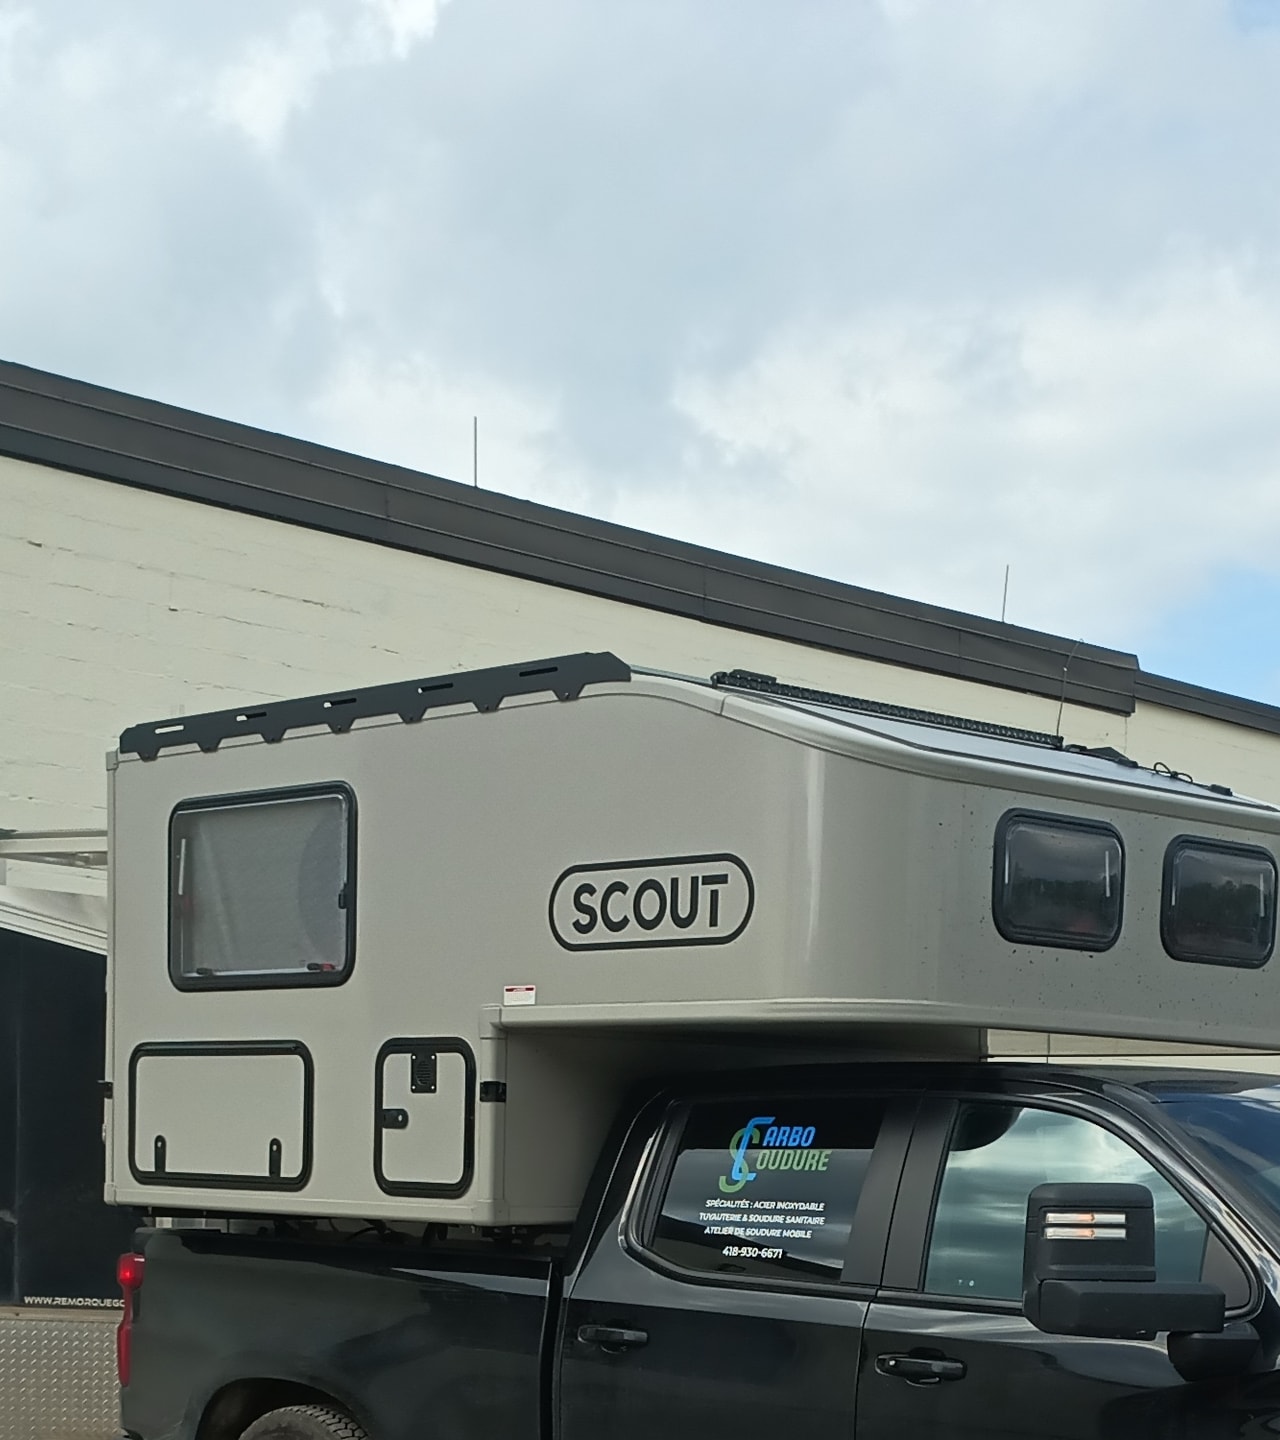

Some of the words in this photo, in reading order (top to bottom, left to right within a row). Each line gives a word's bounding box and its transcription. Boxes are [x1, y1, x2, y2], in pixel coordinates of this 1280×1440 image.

[572, 874, 729, 934] SCOUT
[753, 1201, 776, 1209] ACIER
[776, 1201, 825, 1211] INOXYDABLE
[699, 1212, 742, 1222] TUYAUTERIE
[748, 1214, 785, 1224] SOUDURE
[785, 1216, 825, 1225] SANITAIRE
[704, 1226, 733, 1236] ATELIER
[734, 1227, 745, 1236] DE
[745, 1228, 782, 1237] SOUDURE
[782, 1229, 812, 1239] MOBILE
[722, 1246, 783, 1259] 418-930-6671
